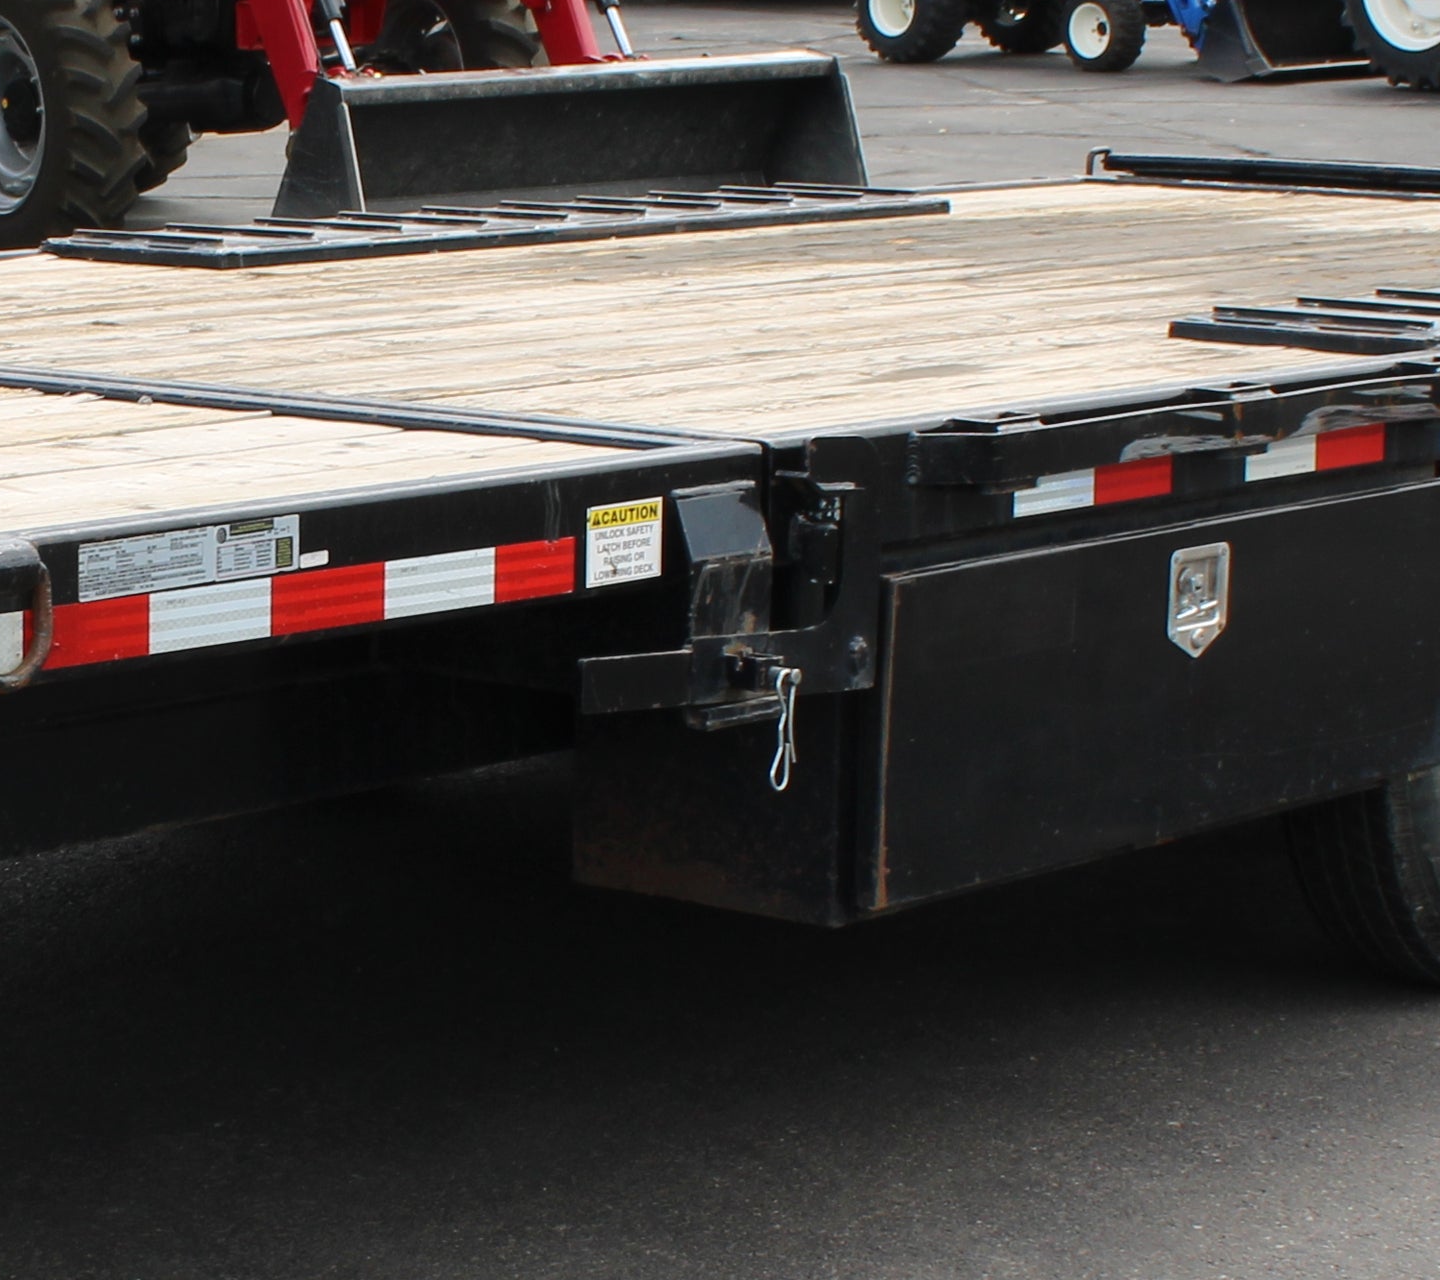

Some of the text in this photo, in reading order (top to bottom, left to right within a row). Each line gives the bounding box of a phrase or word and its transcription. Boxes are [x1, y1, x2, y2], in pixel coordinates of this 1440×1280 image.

[601, 504, 659, 525] CAUTION
[594, 524, 654, 541] UNLOCK SAFETY
[596, 537, 652, 554] LATCH BEFORE
[633, 563, 654, 575] DECK
